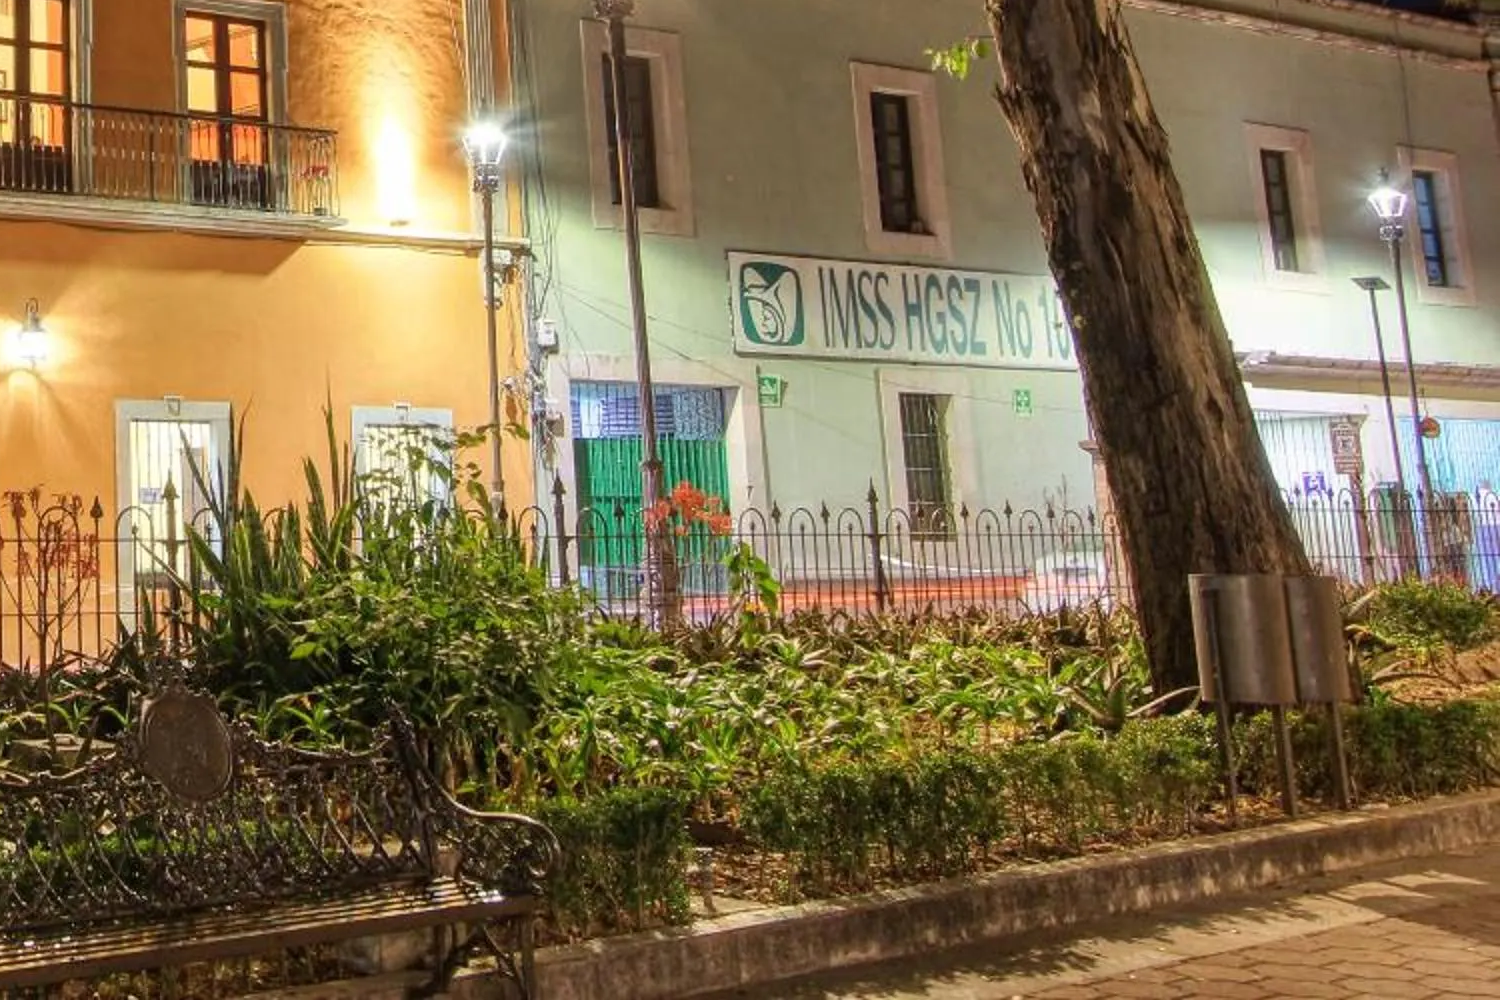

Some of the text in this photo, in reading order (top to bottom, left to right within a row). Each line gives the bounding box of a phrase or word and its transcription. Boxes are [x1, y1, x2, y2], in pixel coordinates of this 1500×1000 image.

[818, 266, 895, 350] IMSS
[902, 272, 986, 356] HGSZ
[992, 280, 1032, 358] No
